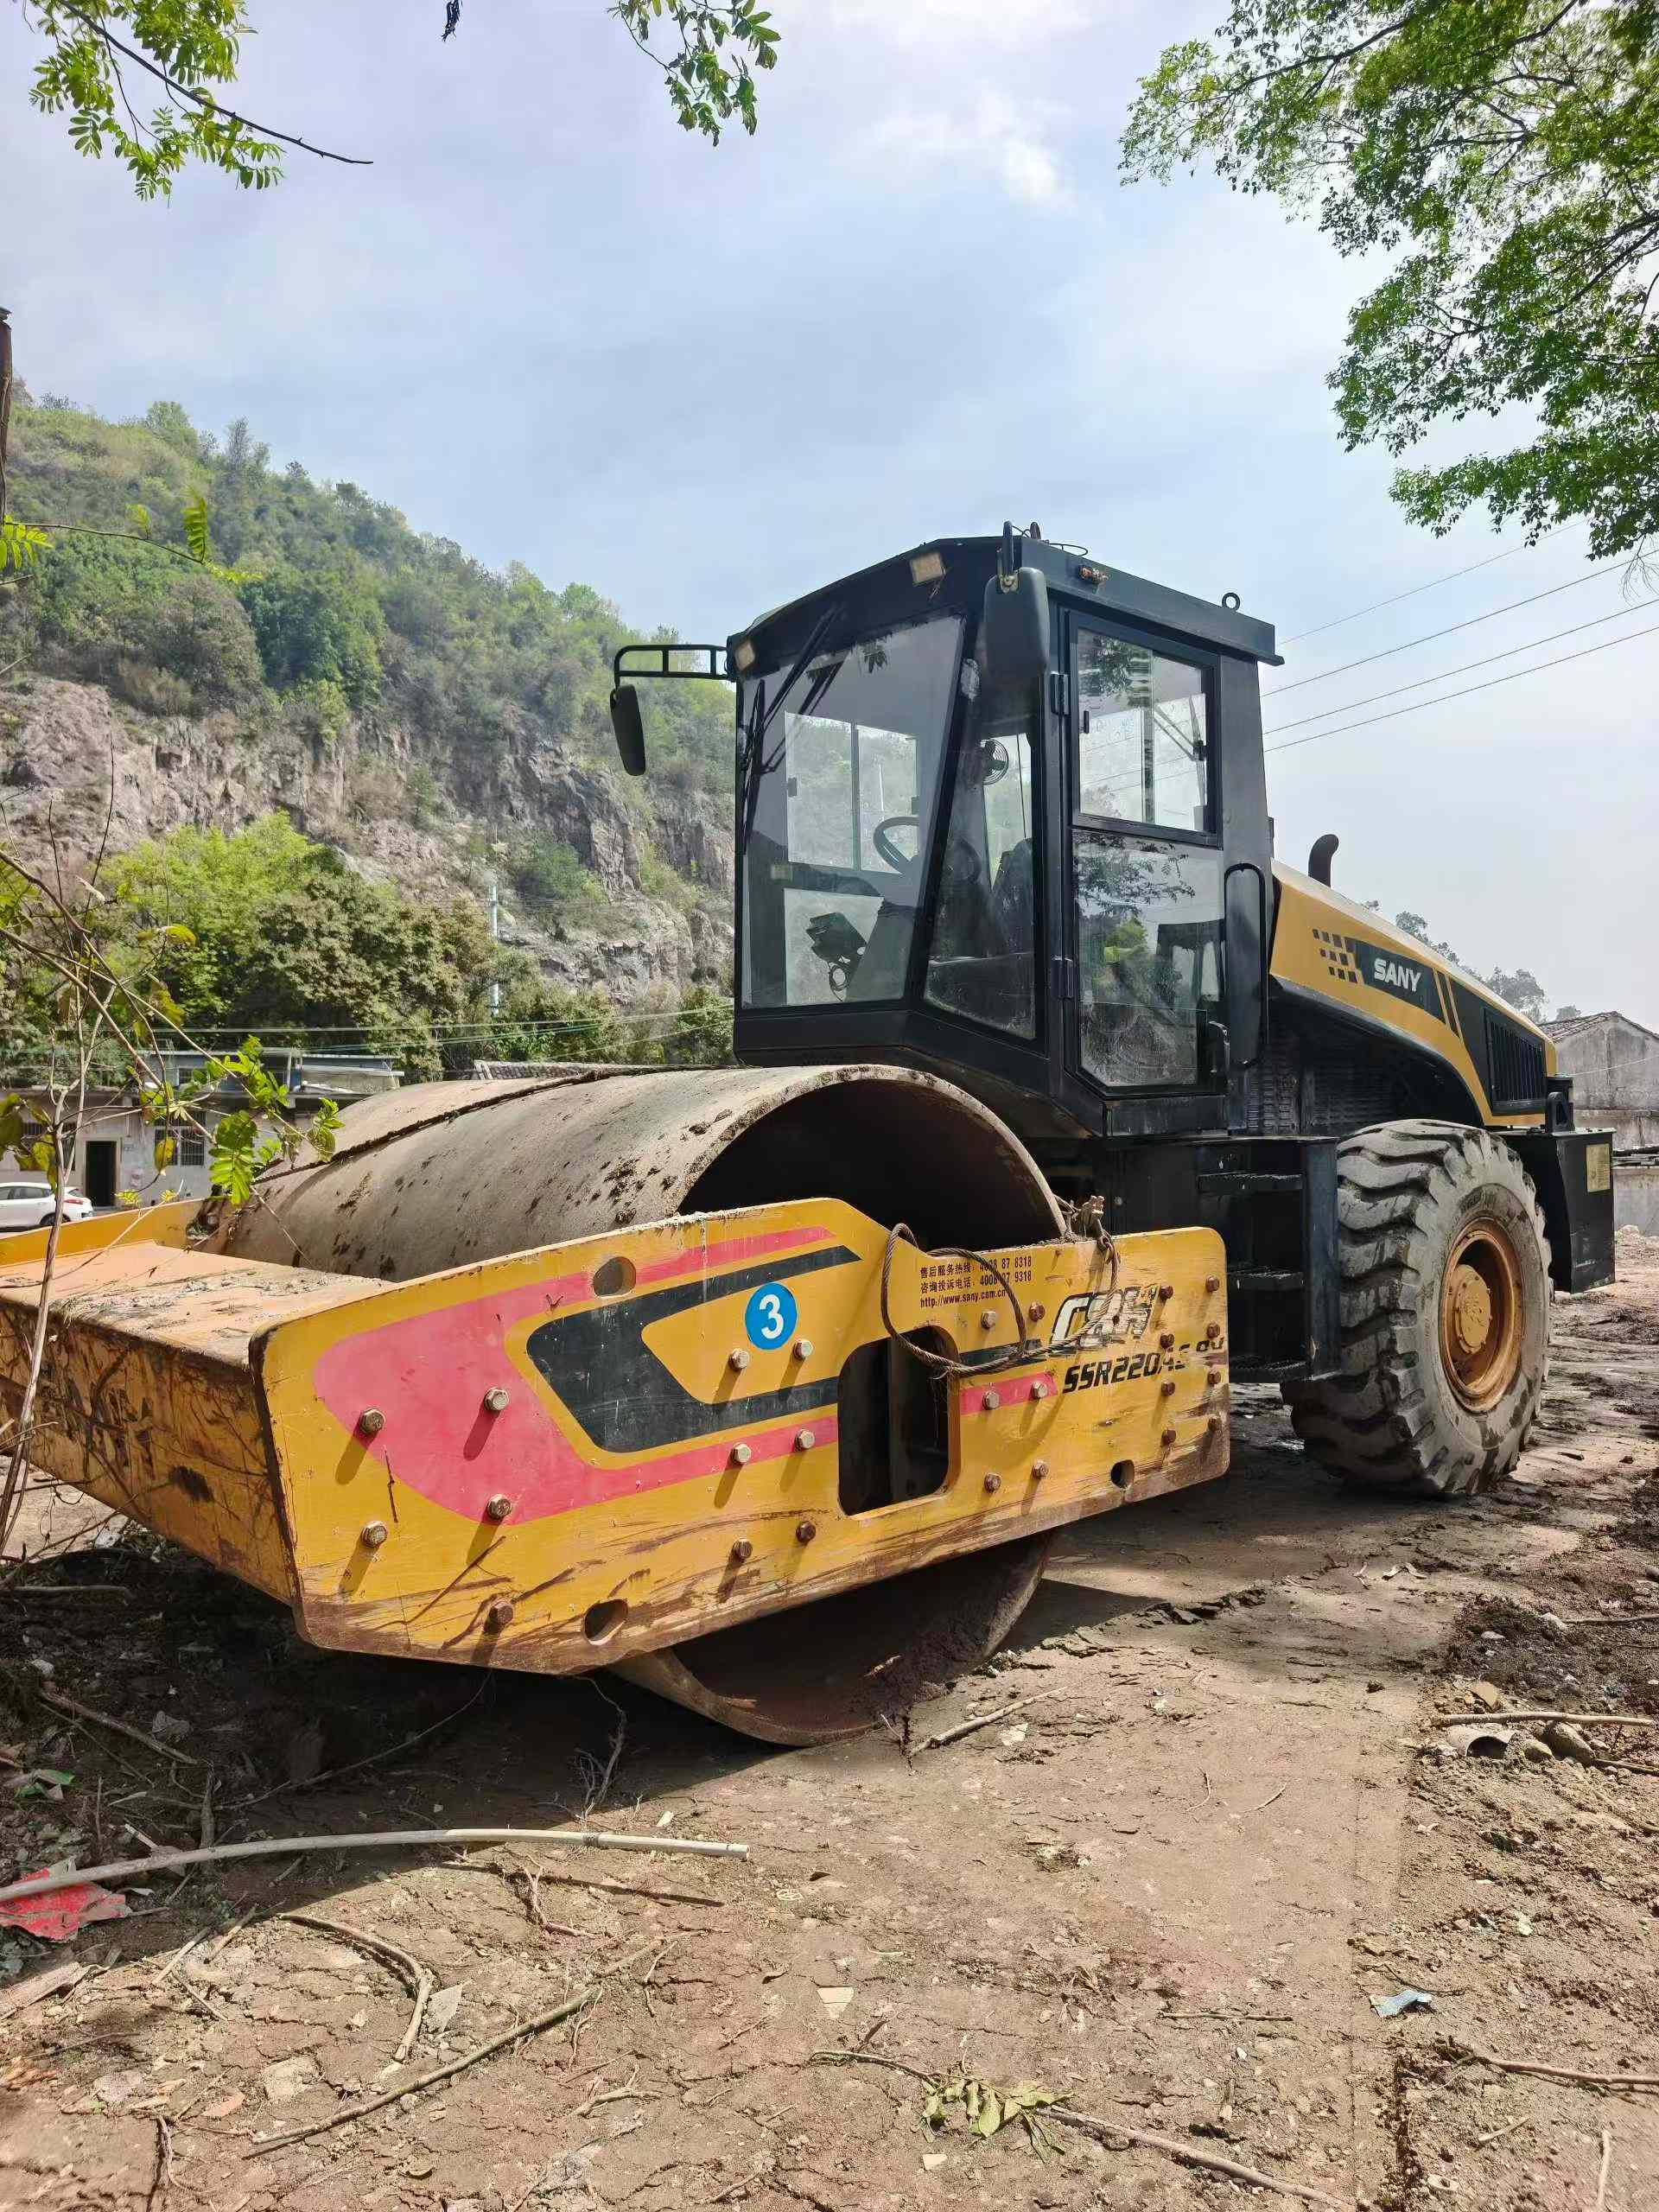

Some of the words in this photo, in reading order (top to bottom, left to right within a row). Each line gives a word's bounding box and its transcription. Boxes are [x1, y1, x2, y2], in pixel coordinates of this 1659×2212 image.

[1374, 957, 1422, 992] SANY
[1001, 1258, 1010, 1269] 87
[1014, 1255, 1032, 1268] 8318
[1014, 1270, 1032, 1283] 9318
[759, 1294, 784, 1339] 3
